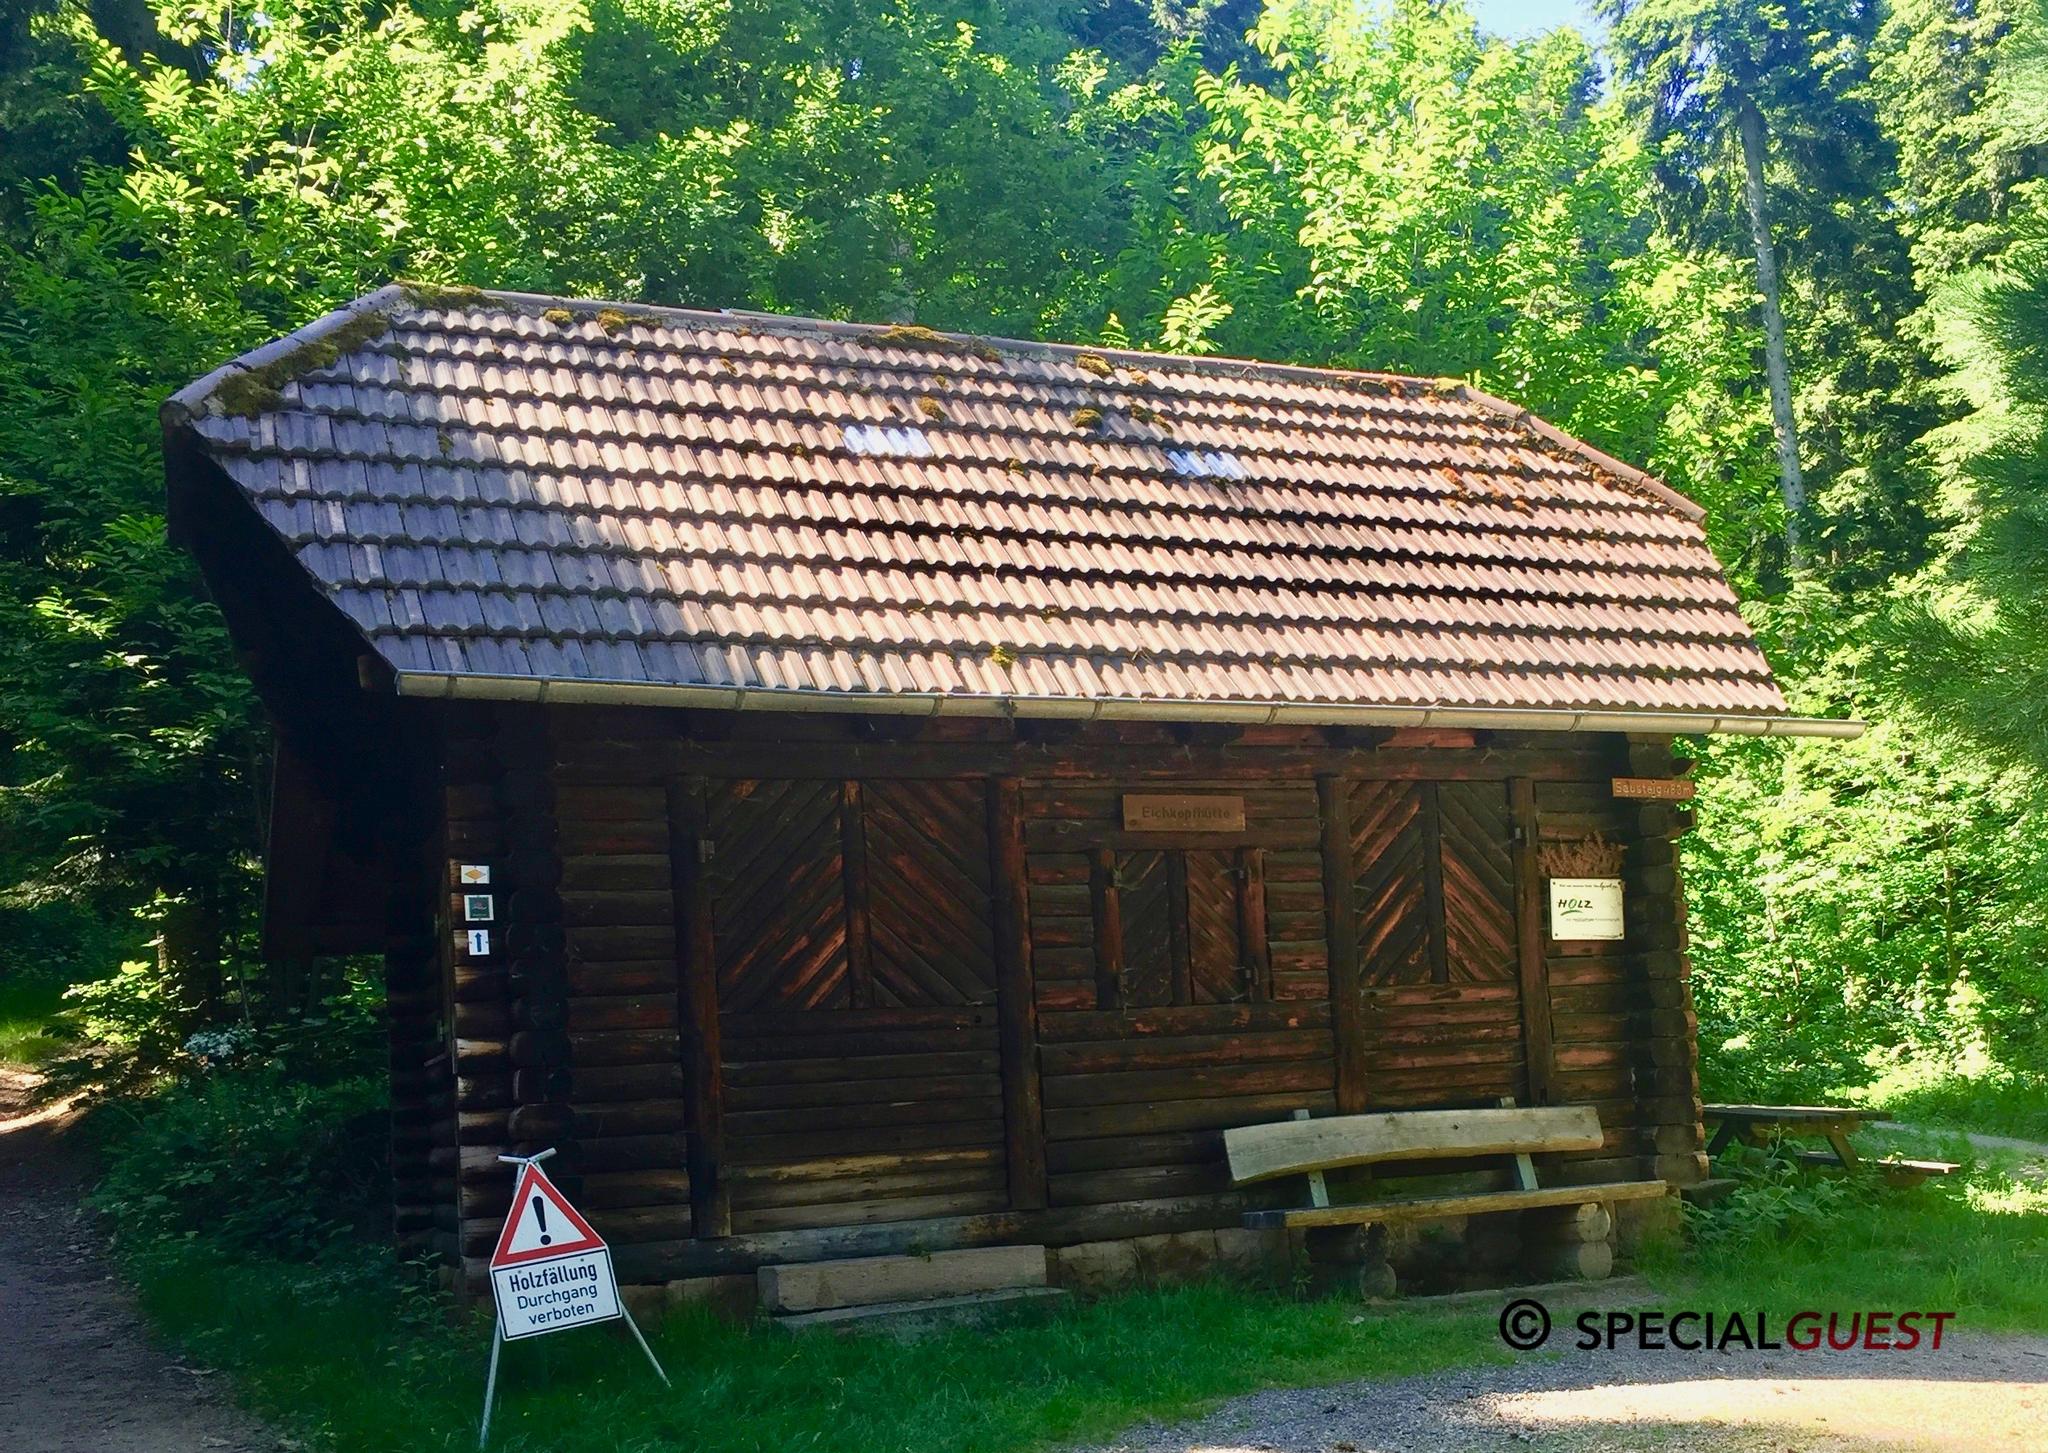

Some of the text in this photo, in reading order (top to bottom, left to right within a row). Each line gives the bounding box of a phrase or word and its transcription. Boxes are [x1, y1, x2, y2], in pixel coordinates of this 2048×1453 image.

[1141, 806, 1230, 821] Eichkopfhütte
[1557, 898, 1593, 909] HOLZ
[509, 1264, 598, 1292] Holzfällung
[517, 1285, 598, 1310] Durchgang
[528, 1303, 595, 1325] verboten
